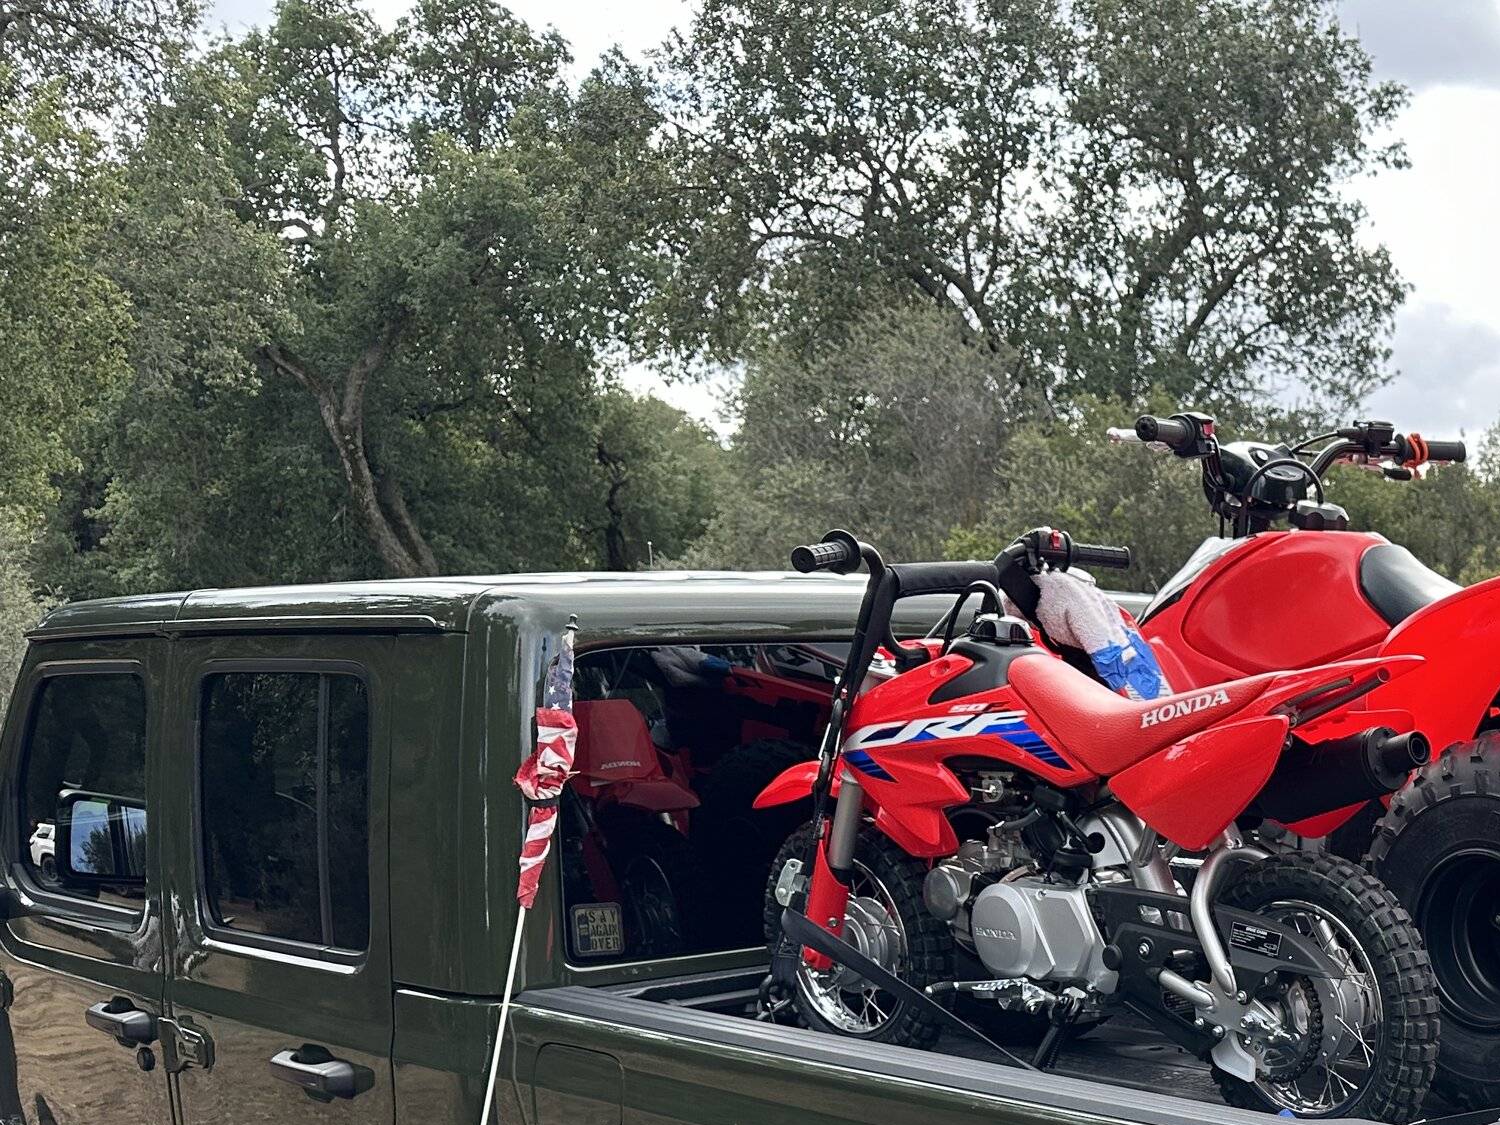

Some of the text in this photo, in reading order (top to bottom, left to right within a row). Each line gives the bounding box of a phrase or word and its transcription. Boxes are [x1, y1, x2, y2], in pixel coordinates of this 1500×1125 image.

[1140, 689, 1231, 729] HONDA
[841, 709, 1029, 753] CRF
[588, 910, 617, 923] SAY
